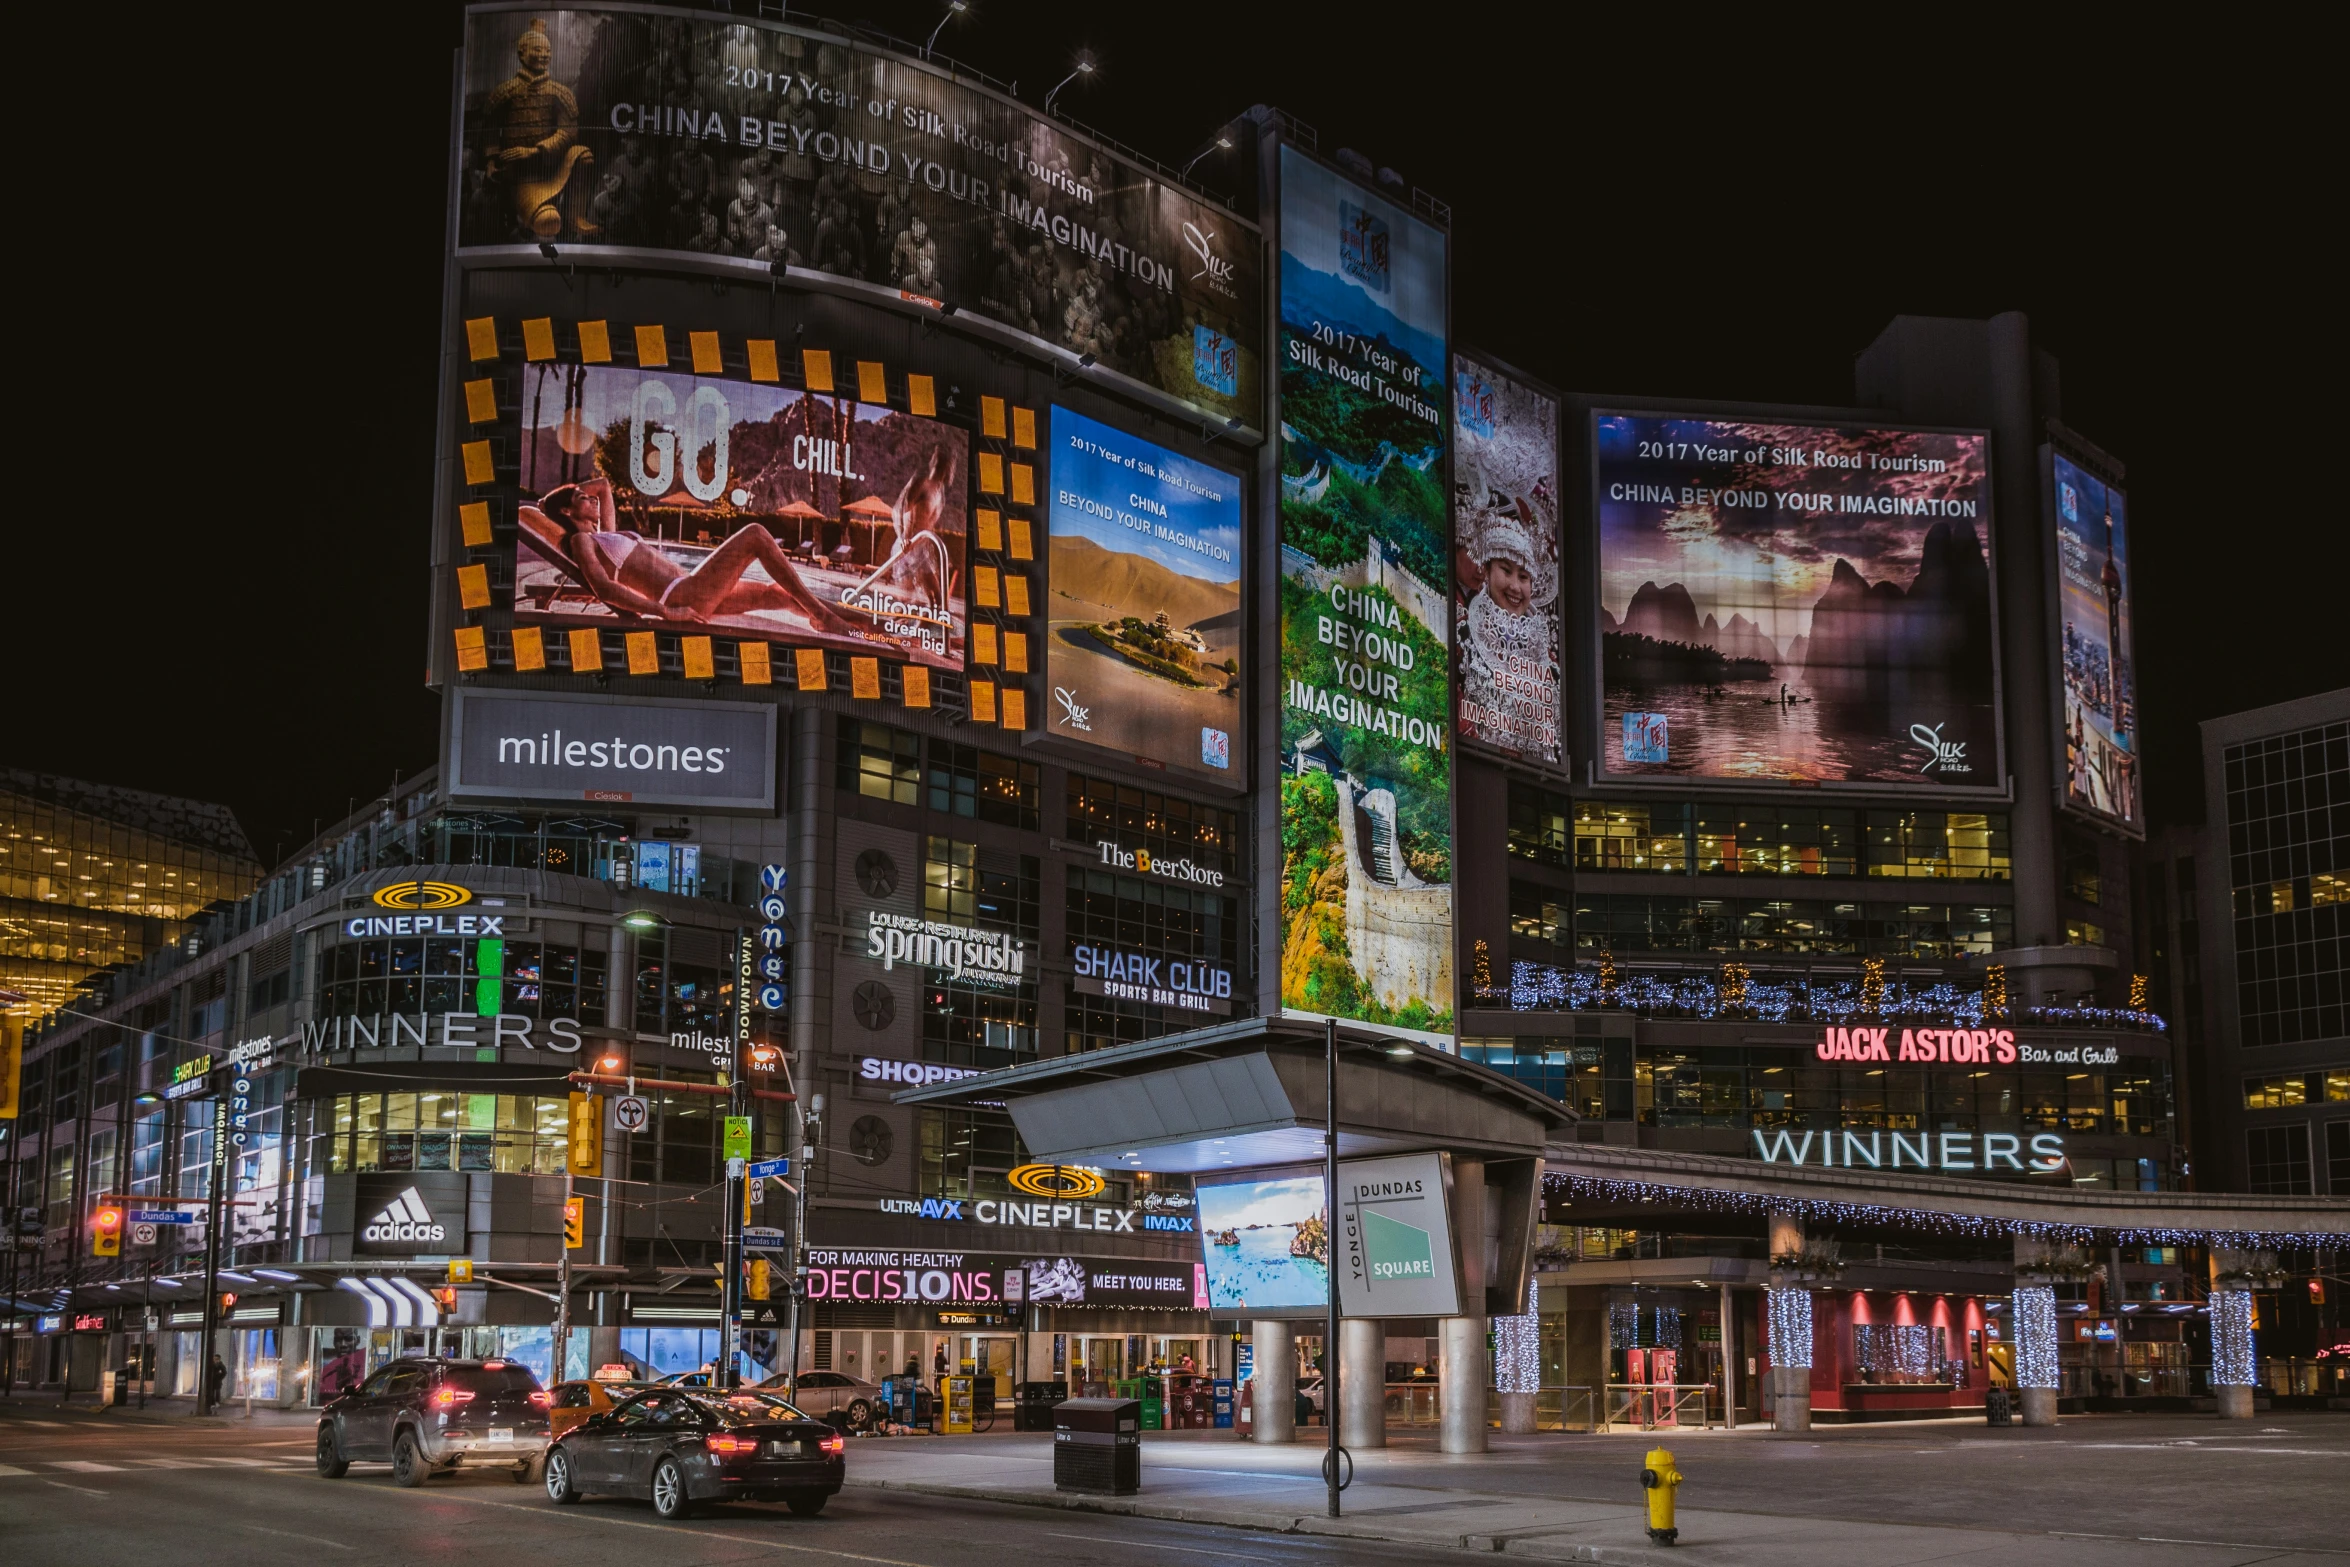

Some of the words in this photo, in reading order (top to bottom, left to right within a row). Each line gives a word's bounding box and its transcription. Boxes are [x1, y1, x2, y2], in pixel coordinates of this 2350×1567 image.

[725, 65, 793, 96] 2017
[798, 71, 859, 110] Year
[867, 98, 897, 121] of
[902, 104, 947, 139] Silk
[953, 123, 1008, 163] Road
[1013, 148, 1094, 205] Tourism
[610, 102, 728, 142] CHINA
[739, 116, 890, 175] BEYOND
[901, 150, 990, 207] YOUR
[1000, 189, 1173, 294] IMAGINATION
[1311, 320, 1356, 354] 2017
[1359, 338, 1398, 374] Year
[1402, 366, 1421, 387] of
[1289, 339, 1323, 372] Silk
[1328, 355, 1371, 393] Road
[1374, 376, 1440, 425] Tourism
[793, 434, 866, 482] CHILL.
[1071, 435, 1097, 455] 2017
[1098, 446, 1122, 464] Year
[1124, 456, 1137, 469] of
[1137, 460, 1157, 478] Silk
[1158, 468, 1183, 487] Road
[1184, 477, 1222, 502] Tourism
[1638, 440, 1688, 461] 2017
[1693, 443, 1739, 464] Year
[1743, 446, 1767, 465] of
[1771, 447, 1808, 467] Silk
[1813, 449, 1862, 469] Road
[1868, 452, 1946, 473] Tourism
[1129, 493, 1168, 519] CHINA
[1610, 482, 1675, 504] CHINA
[1681, 486, 1769, 509] BEYOND
[1773, 491, 1834, 512] YOUR
[1838, 495, 1977, 518] IMAGINATION
[1059, 489, 1113, 521] BEYOND
[1116, 510, 1152, 535] YOUR
[1154, 523, 1231, 564] IMAGINATION
[841, 587, 951, 626] California
[1331, 583, 1402, 633] CHINA
[848, 629, 911, 648] visitcalifornia.ca
[884, 619, 931, 639] dream
[921, 636, 946, 655] big
[1318, 615, 1414, 671] BEYOND
[1333, 656, 1399, 703] YOUR
[1509, 655, 1554, 685] CHINA
[1494, 670, 1554, 705] BEYOND
[1289, 678, 1441, 750] IMAGINATION
[1461, 699, 1555, 747] IMAGINATION
[1514, 697, 1554, 726] YOUR
[499, 729, 727, 774] milestones
[349, 915, 503, 937] CINEPLEX
[869, 910, 919, 932] LOUNGE
[925, 920, 1002, 945] RESTAURANT
[740, 936, 752, 1039] DOWNTOWN
[1074, 944, 1162, 988] SHARK
[1169, 962, 1232, 999] CLUB
[1104, 980, 1148, 1002] SPORTS
[1152, 988, 1176, 1007] BAR
[1179, 992, 1210, 1011] GRILL
[229, 1034, 272, 1065] milestones
[301, 1011, 582, 1055] WINNERS
[1817, 1027, 1890, 1062] JACK
[2018, 1046, 2051, 1062] Bar
[2054, 1047, 2079, 1063] and
[2082, 1047, 2119, 1064] Grill
[174, 1060, 194, 1085] SHARK
[194, 1053, 211, 1077] CLUB
[754, 1062, 775, 1073] BAR
[215, 1102, 227, 1166] DOWNTOWN
[1752, 1129, 2064, 1171] WINNERS
[759, 1163, 775, 1176] Yonge
[1360, 1180, 1423, 1197] DUNDAS
[141, 1211, 175, 1221] Dundas
[365, 1221, 446, 1242] adidas
[975, 1200, 1135, 1233] CINEPLEX
[1144, 1214, 1194, 1233] IMAX
[746, 1236, 770, 1246] Dundas
[1346, 1212, 1364, 1280] YONGE
[808, 1251, 838, 1265] FOR
[842, 1252, 899, 1266] MAKING
[902, 1253, 964, 1268] HEALTHY
[1374, 1260, 1431, 1278] SQUARE
[1093, 1274, 1126, 1288] MEET
[1128, 1275, 1152, 1290] YOU
[1154, 1277, 1186, 1291] HERE.
[951, 1315, 977, 1324] Dundas
[1056, 1432, 1067, 1440] Litter
[1117, 1436, 1130, 1444] Litter
